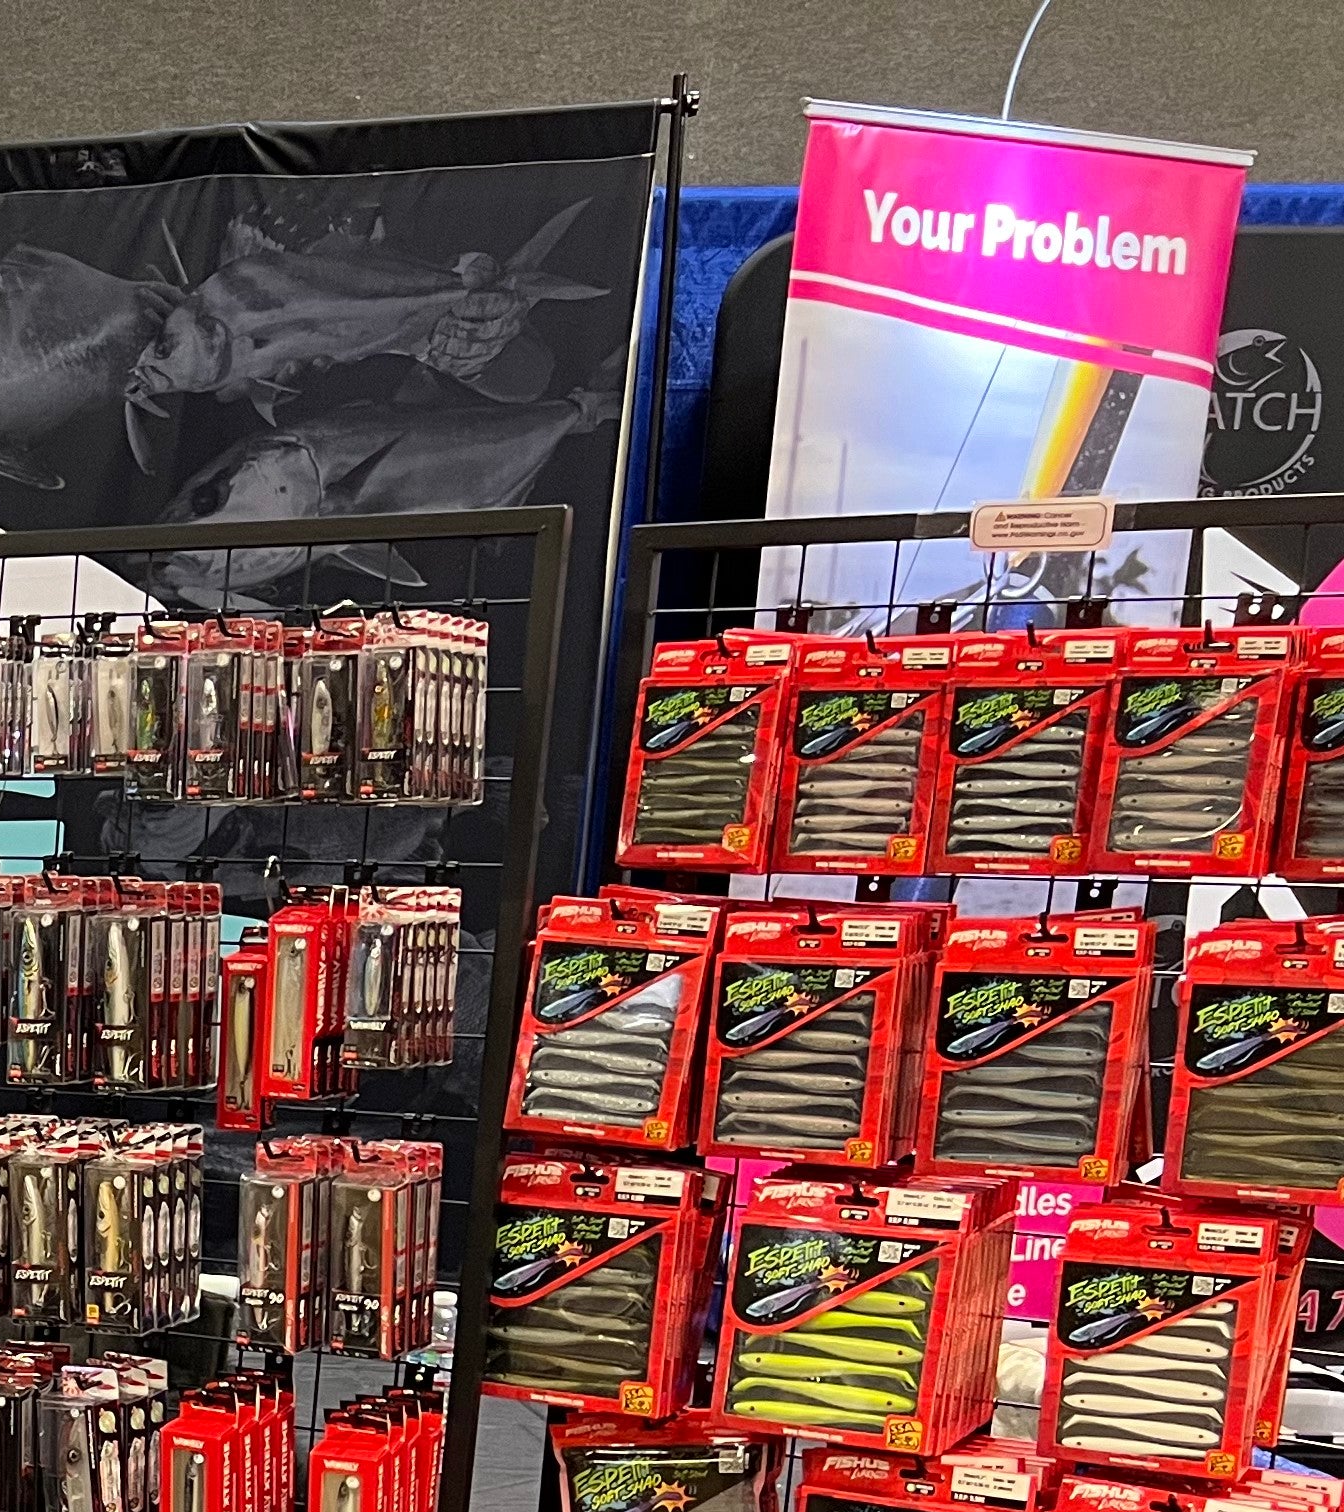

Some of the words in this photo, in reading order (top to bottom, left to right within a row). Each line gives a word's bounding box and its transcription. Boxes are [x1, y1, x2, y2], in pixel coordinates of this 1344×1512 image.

[863, 189, 975, 254] Your
[981, 203, 1189, 277] Problem
[1208, 391, 1322, 432] ATCH
[363, 1297, 380, 1311] 90
